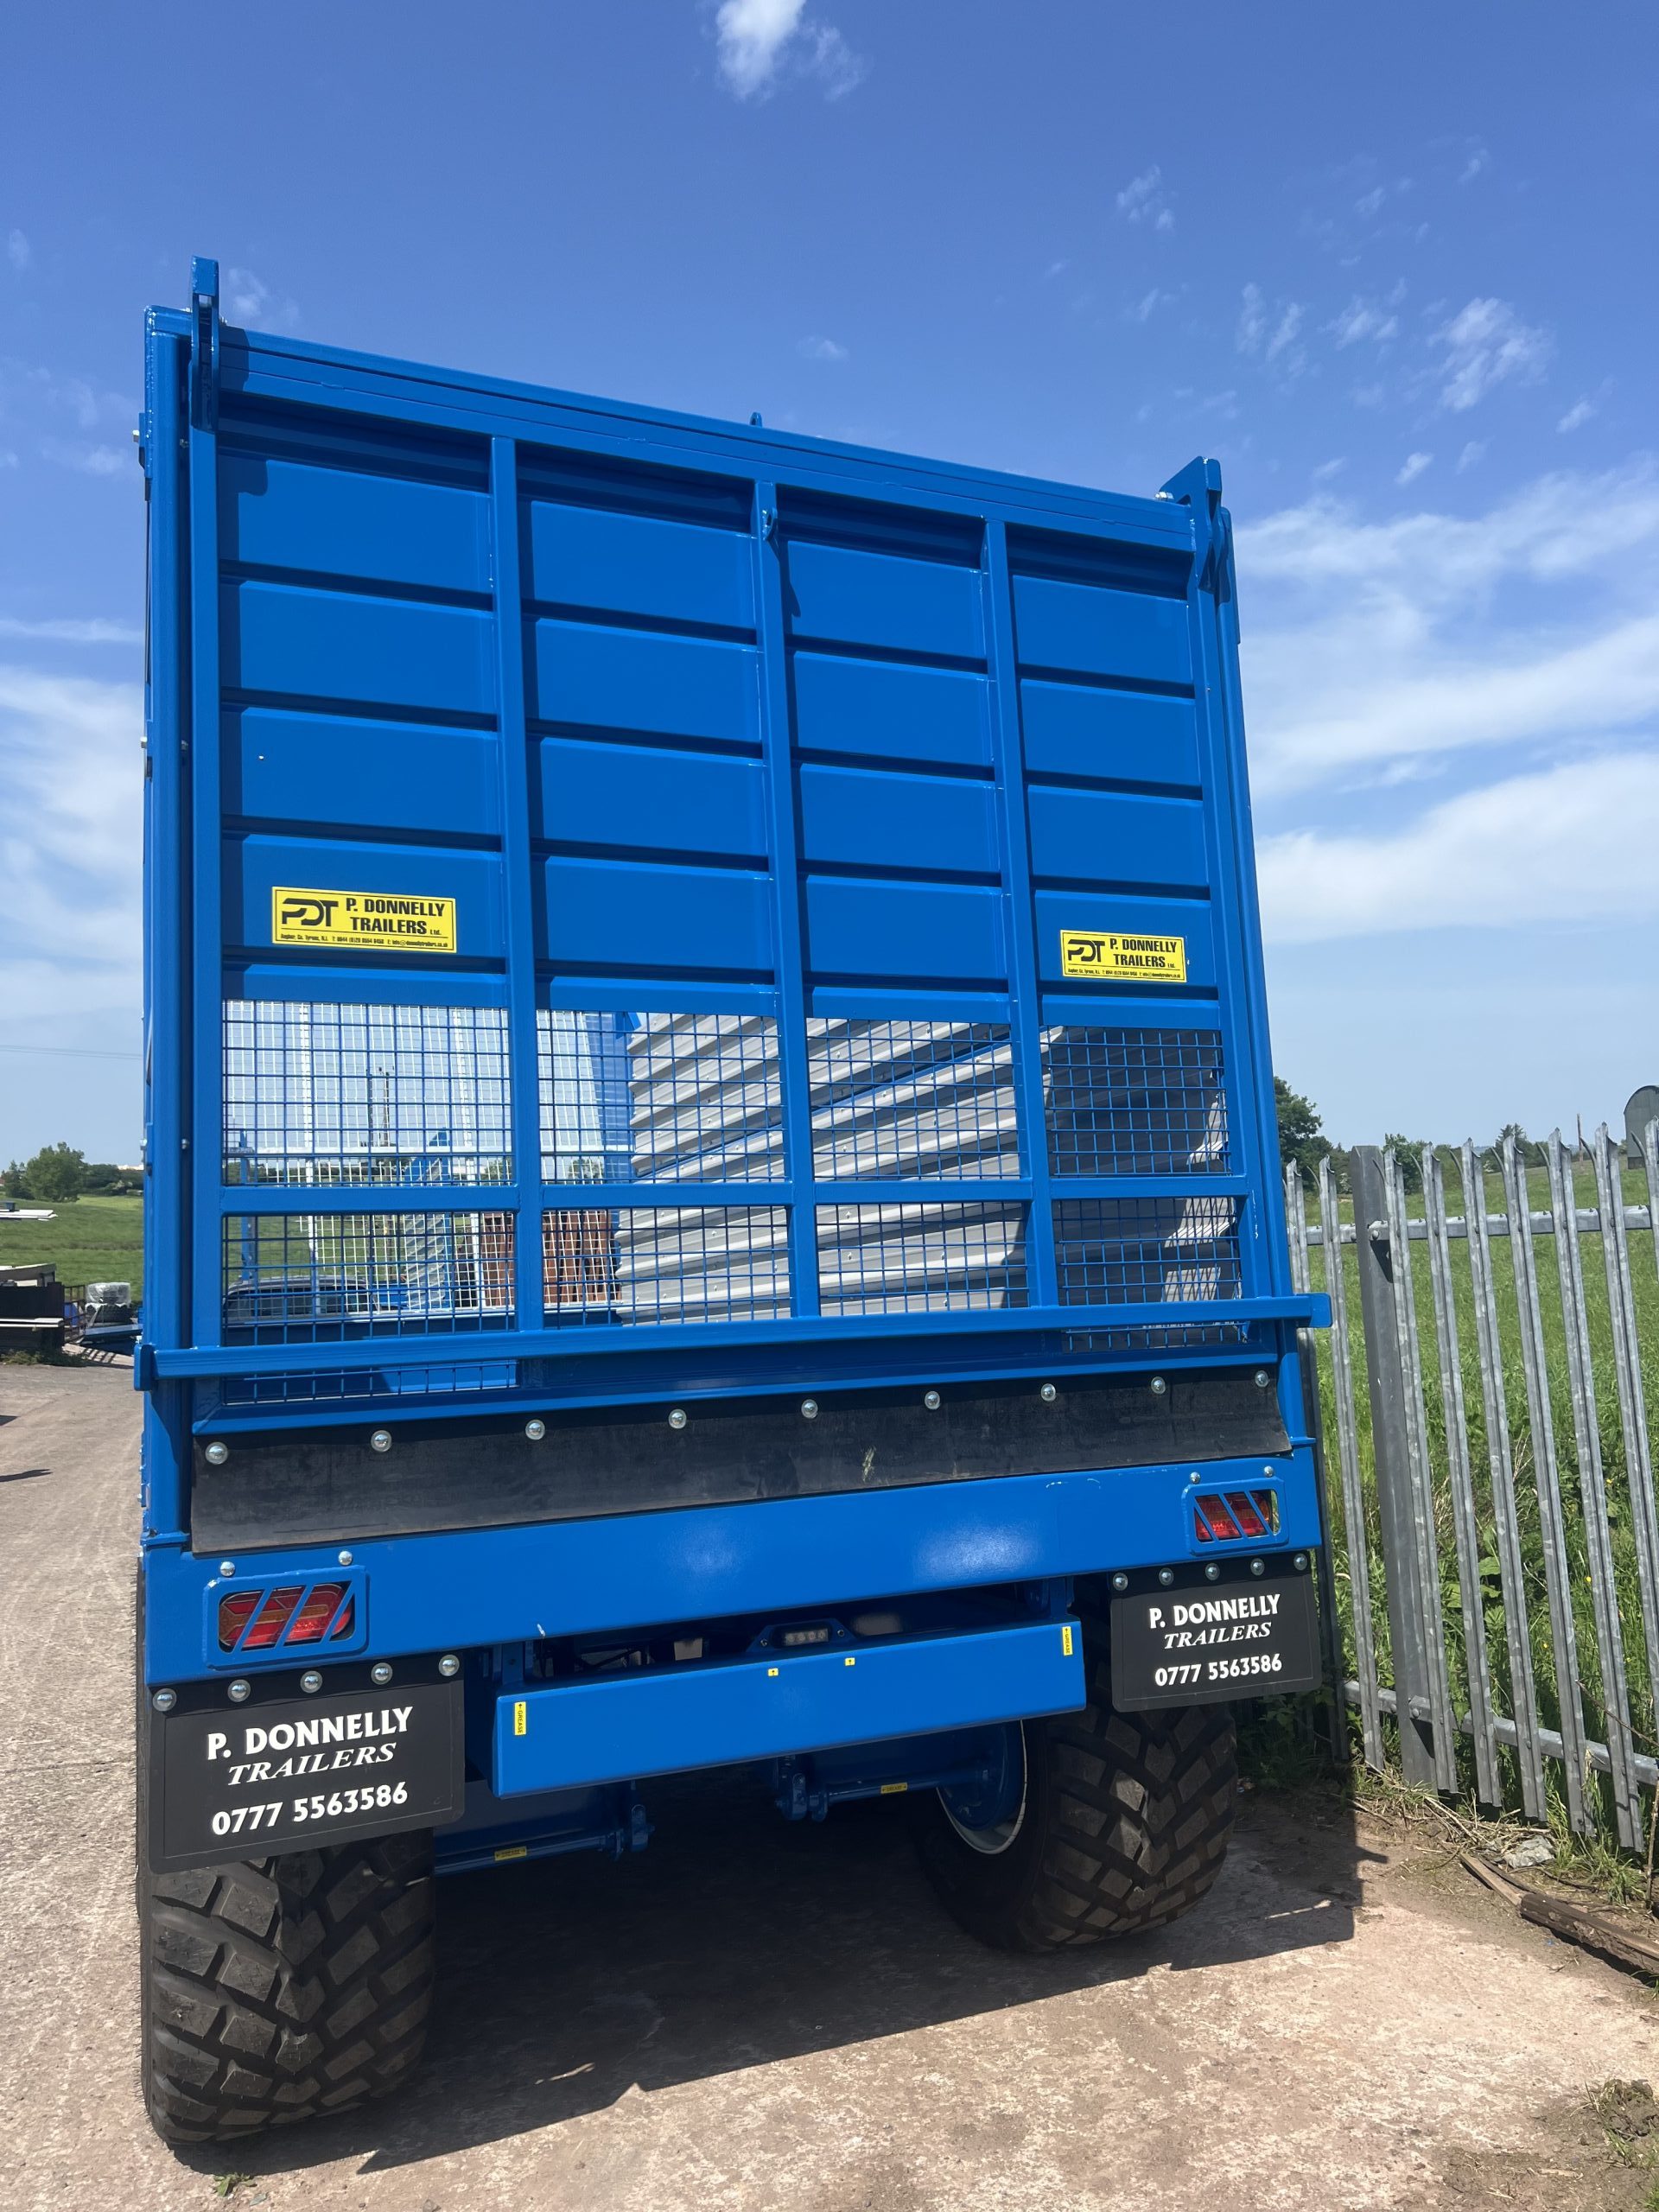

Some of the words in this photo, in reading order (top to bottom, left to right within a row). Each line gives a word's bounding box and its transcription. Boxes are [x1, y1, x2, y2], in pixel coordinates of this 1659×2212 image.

[281, 897, 339, 927] PDT
[346, 897, 359, 912] P.
[364, 899, 445, 917] DONNELLY
[350, 917, 427, 935] TRAILERS
[1067, 938, 1106, 963] PDT
[1109, 938, 1119, 950] P.
[1122, 938, 1177, 953] DONNELLY
[1113, 954, 1166, 968] TRAILERS
[1149, 1607, 1166, 1629] P.
[1173, 1593, 1281, 1627] DONNELLY
[1164, 1621, 1272, 1649] TRAILERS
[1154, 1663, 1202, 1687] 0777
[1208, 1653, 1282, 1681] 5563586
[207, 1732, 232, 1761] P.
[245, 1706, 414, 1755] DONNELLY
[226, 1742, 397, 1786] TRAILERS
[211, 1802, 283, 1835] 0777
[293, 1781, 409, 1823] 5563586
